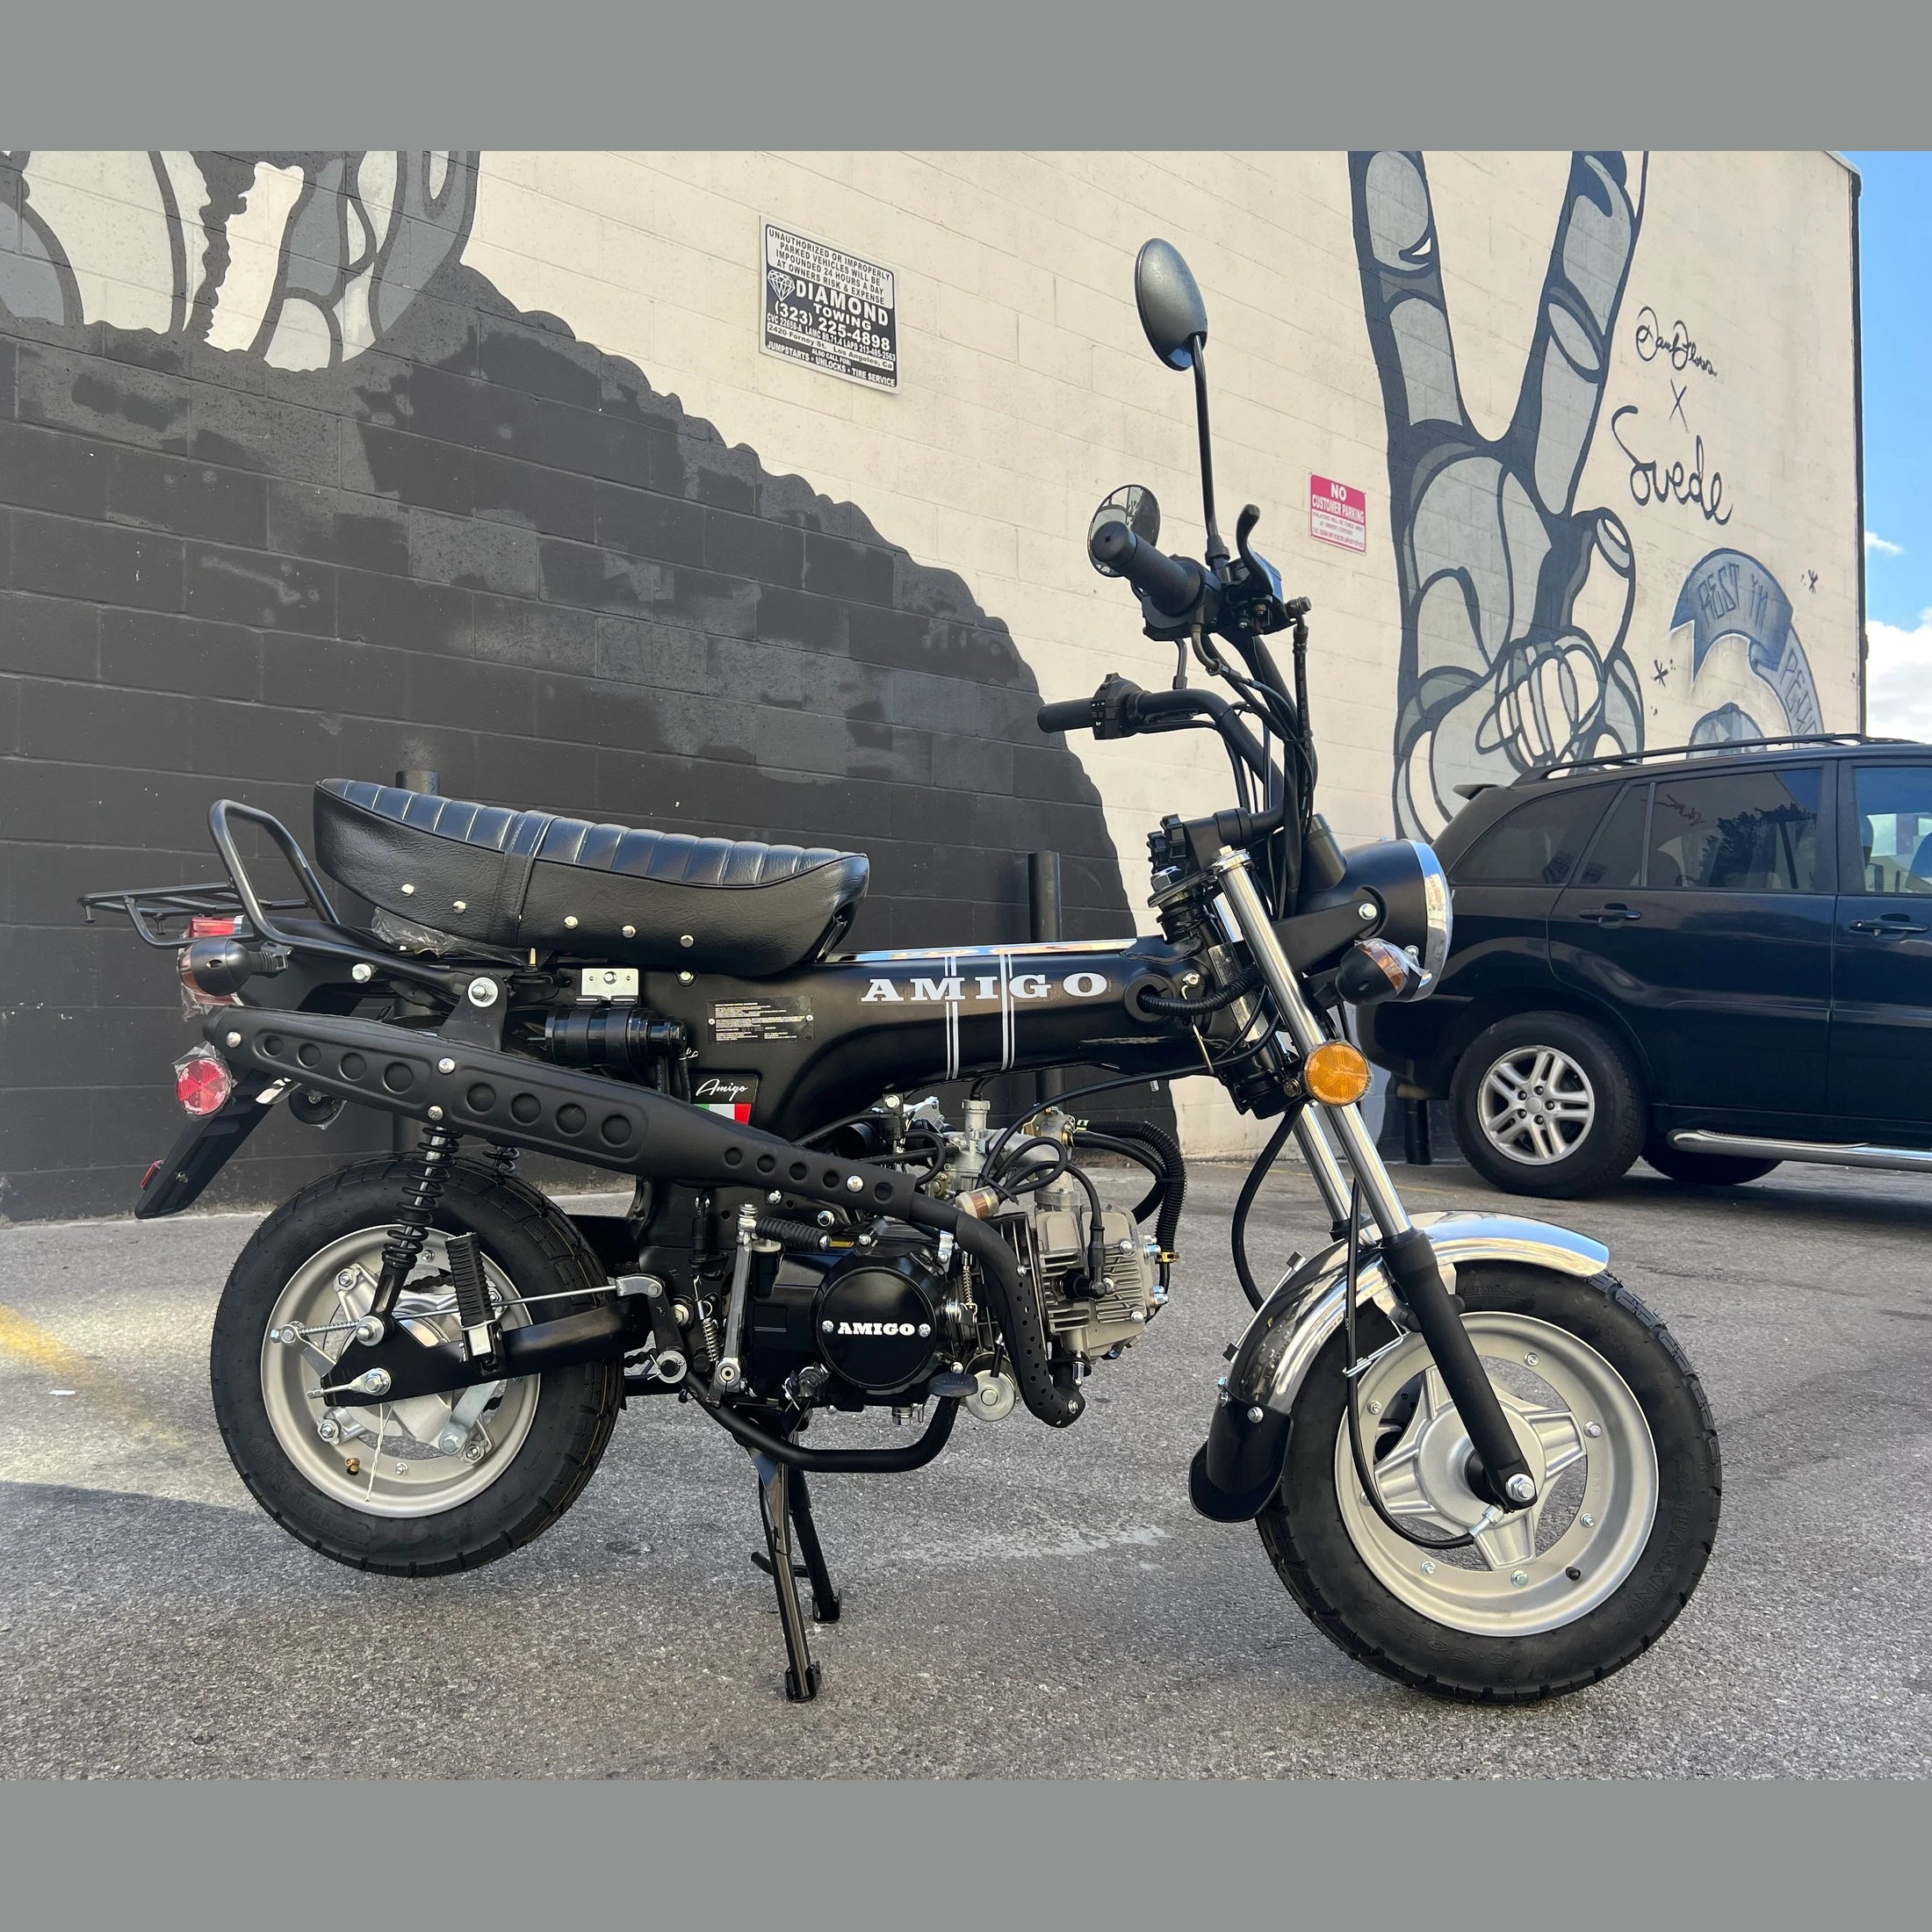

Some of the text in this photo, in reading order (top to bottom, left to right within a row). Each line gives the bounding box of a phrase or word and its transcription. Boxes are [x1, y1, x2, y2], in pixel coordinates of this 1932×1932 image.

[769, 228, 890, 280] UNAUTHORIZED OR IMPROPERLY
[776, 249, 821, 272] IMPOUNDED
[824, 268, 833, 277] 24
[835, 271, 860, 287] HOURS
[870, 285, 883, 295] DAY
[780, 242, 880, 285] PARKED VEHICLES WILL BE
[777, 260, 786, 269] AT
[789, 264, 820, 282] OWNERS
[824, 278, 840, 289] RISK
[852, 287, 884, 305] EXPENSE
[796, 279, 888, 326] DIAMOND
[767, 313, 778, 323] CVC
[805, 326, 821, 338] LAMC
[843, 339, 858, 350] LAPD
[775, 300, 890, 350] (323) 225-4898
[813, 303, 871, 330] TOWING
[768, 324, 787, 335] 2420
[789, 331, 815, 346] Forney
[833, 346, 846, 355] Los
[812, 348, 825, 357] ALSO
[825, 352, 839, 363] CALL
[767, 340, 896, 386] JUMPSTARTS UNLOCKS TIRE SERVICE
[1611, 405, 1734, 525] Suede
[1312, 494, 1364, 523] CUSTOMER PARKING
[1330, 483, 1347, 501] NO
[1698, 561, 1740, 629] REST
[861, 972, 1107, 1002] AMIGO
[696, 1078, 748, 1101] Amigo
[838, 1322, 915, 1336] AMIGO
